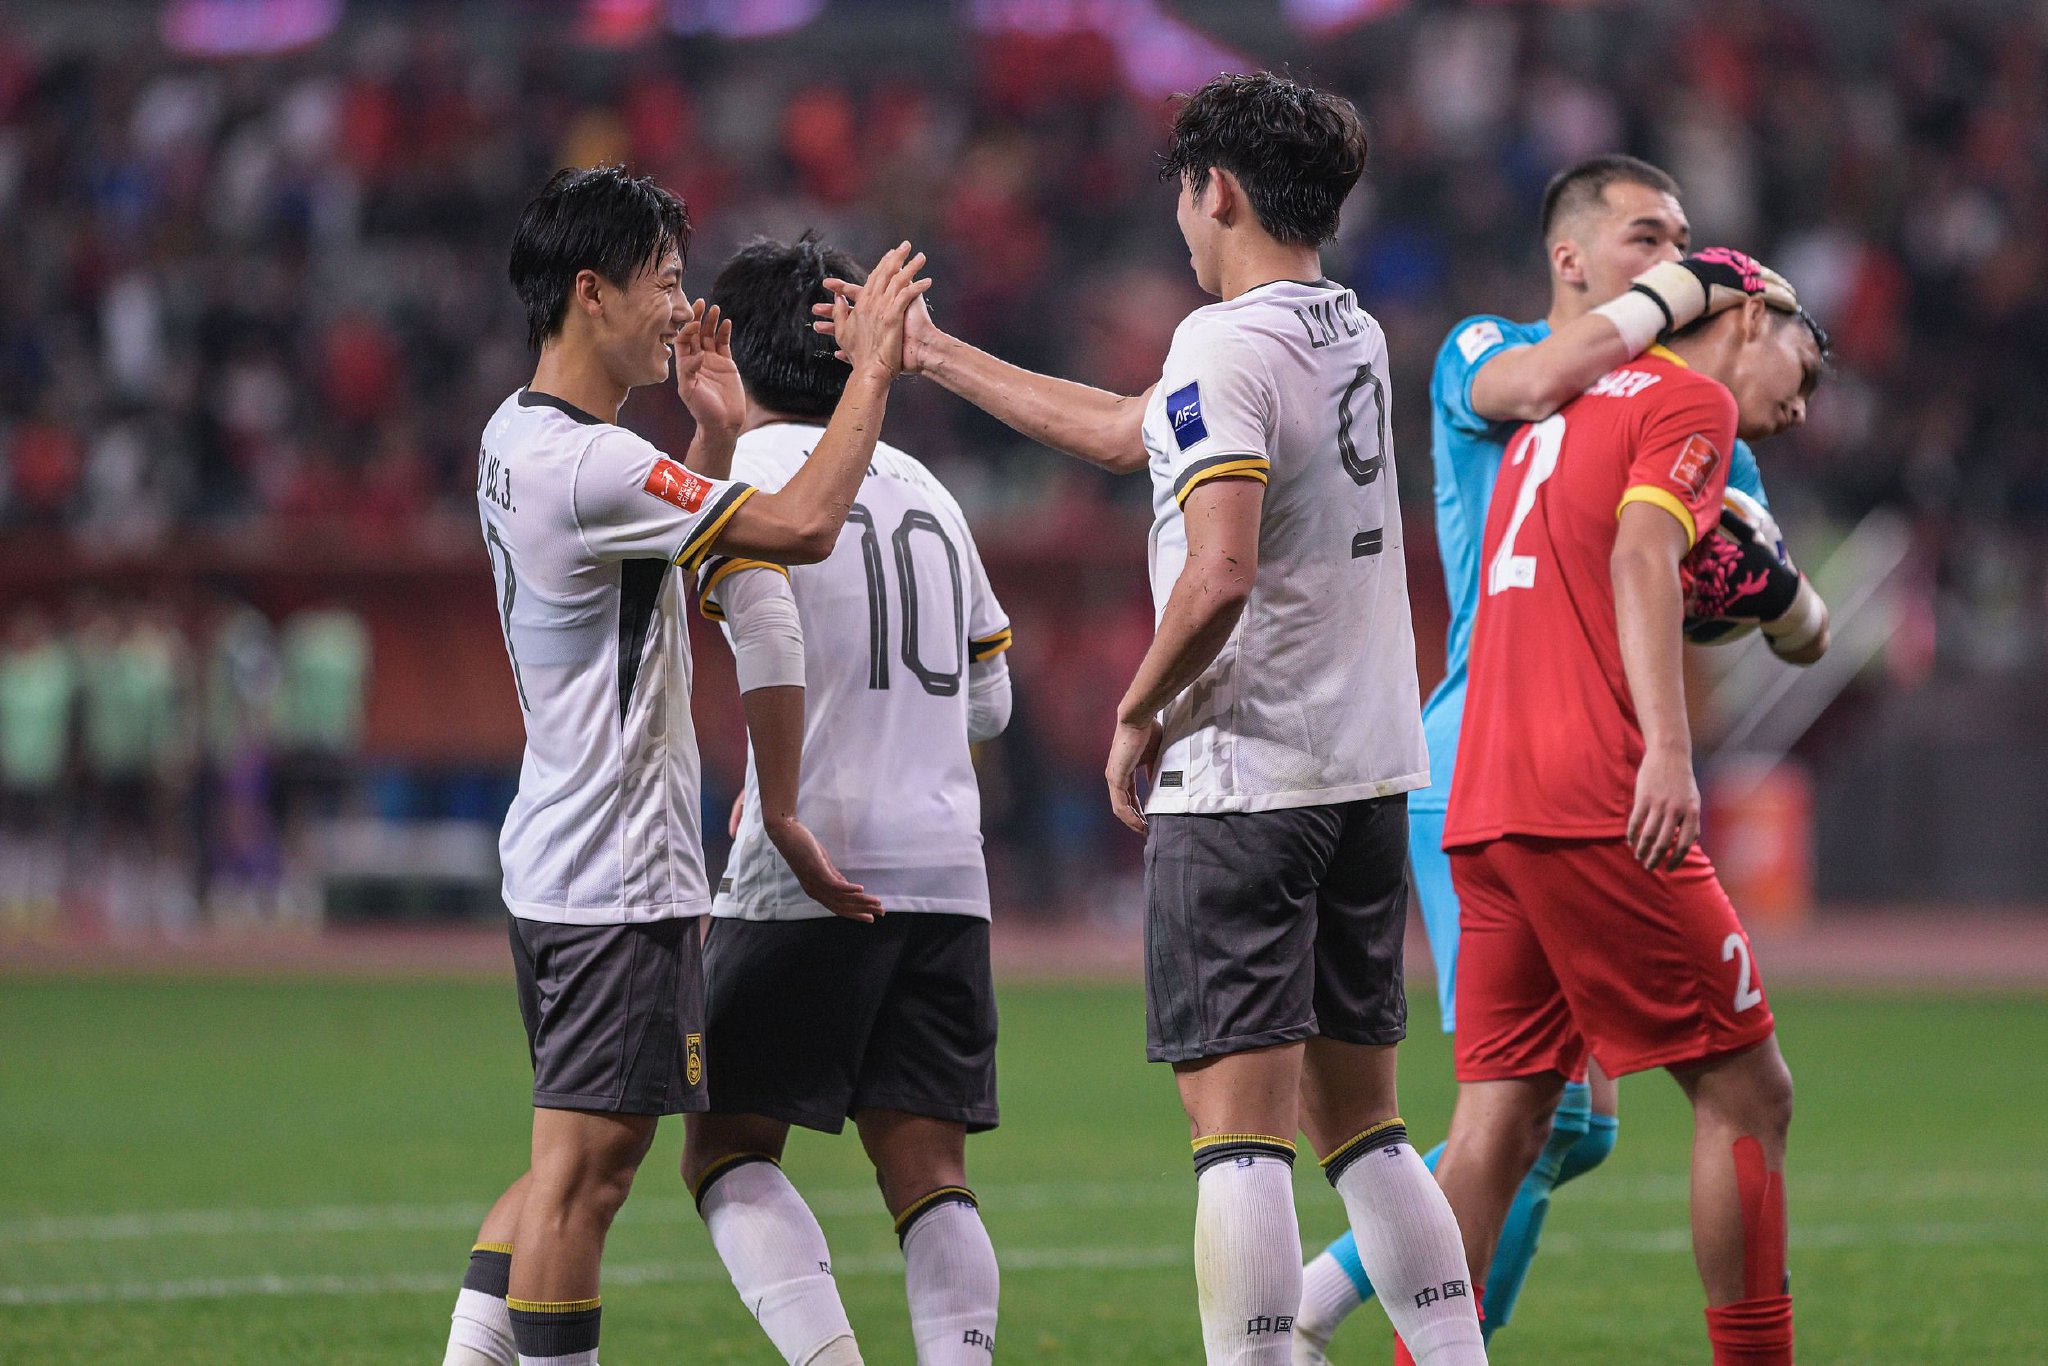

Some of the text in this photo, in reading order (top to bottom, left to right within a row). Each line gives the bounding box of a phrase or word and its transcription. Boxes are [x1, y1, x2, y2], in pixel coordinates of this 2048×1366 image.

[1293, 300, 1339, 348] LIU
[1175, 401, 1200, 428] AFC
[1488, 414, 1566, 596] 2
[1721, 933, 1762, 1013] 2
[1414, 1280, 1466, 1309] 中国
[1247, 1315, 1294, 1335] 中国
